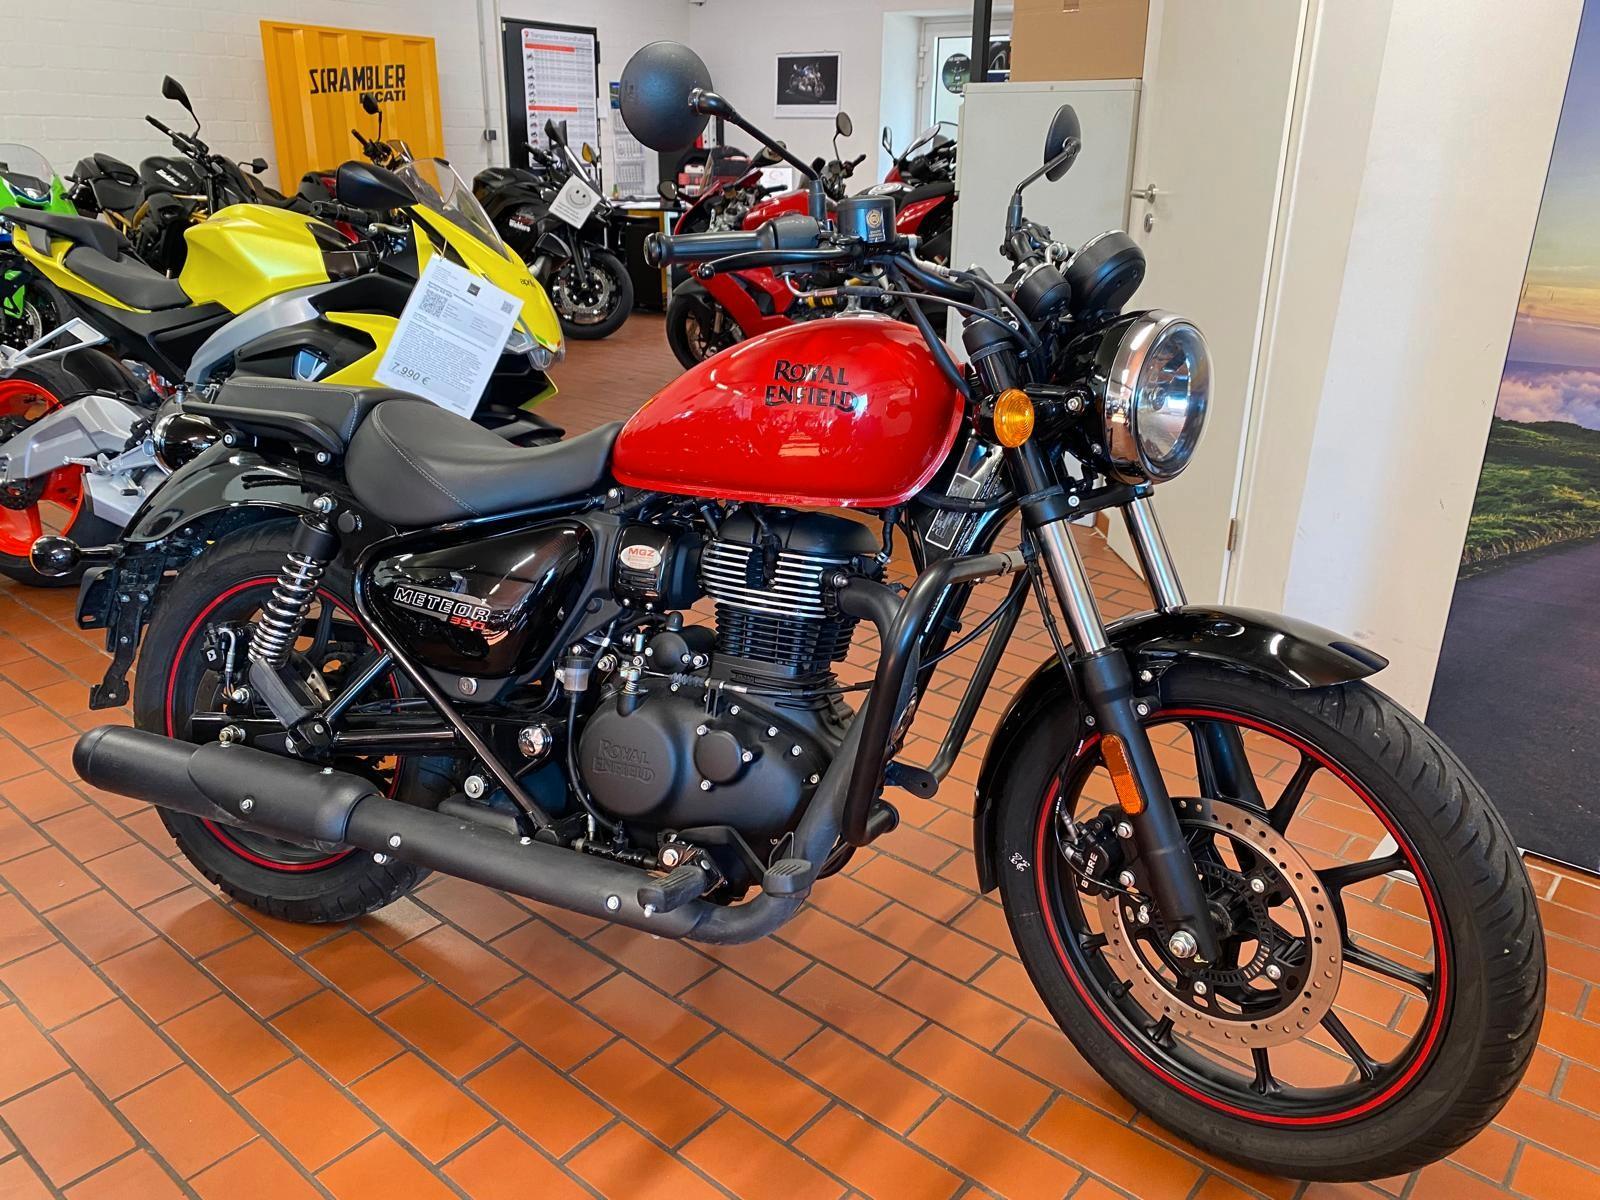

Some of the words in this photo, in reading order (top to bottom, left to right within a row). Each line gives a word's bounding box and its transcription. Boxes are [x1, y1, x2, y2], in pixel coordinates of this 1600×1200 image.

[309, 64, 406, 94] SCRAMBLER
[391, 362, 421, 381] 7.990
[422, 376, 431, 386] €
[774, 360, 849, 385] ROYAL
[765, 385, 859, 412] ENFIELD
[628, 547, 656, 557] MGZ
[394, 587, 491, 622] METEOR
[449, 616, 486, 630] 350
[600, 740, 650, 765] ROYAL
[592, 757, 655, 784] ENFIELD
